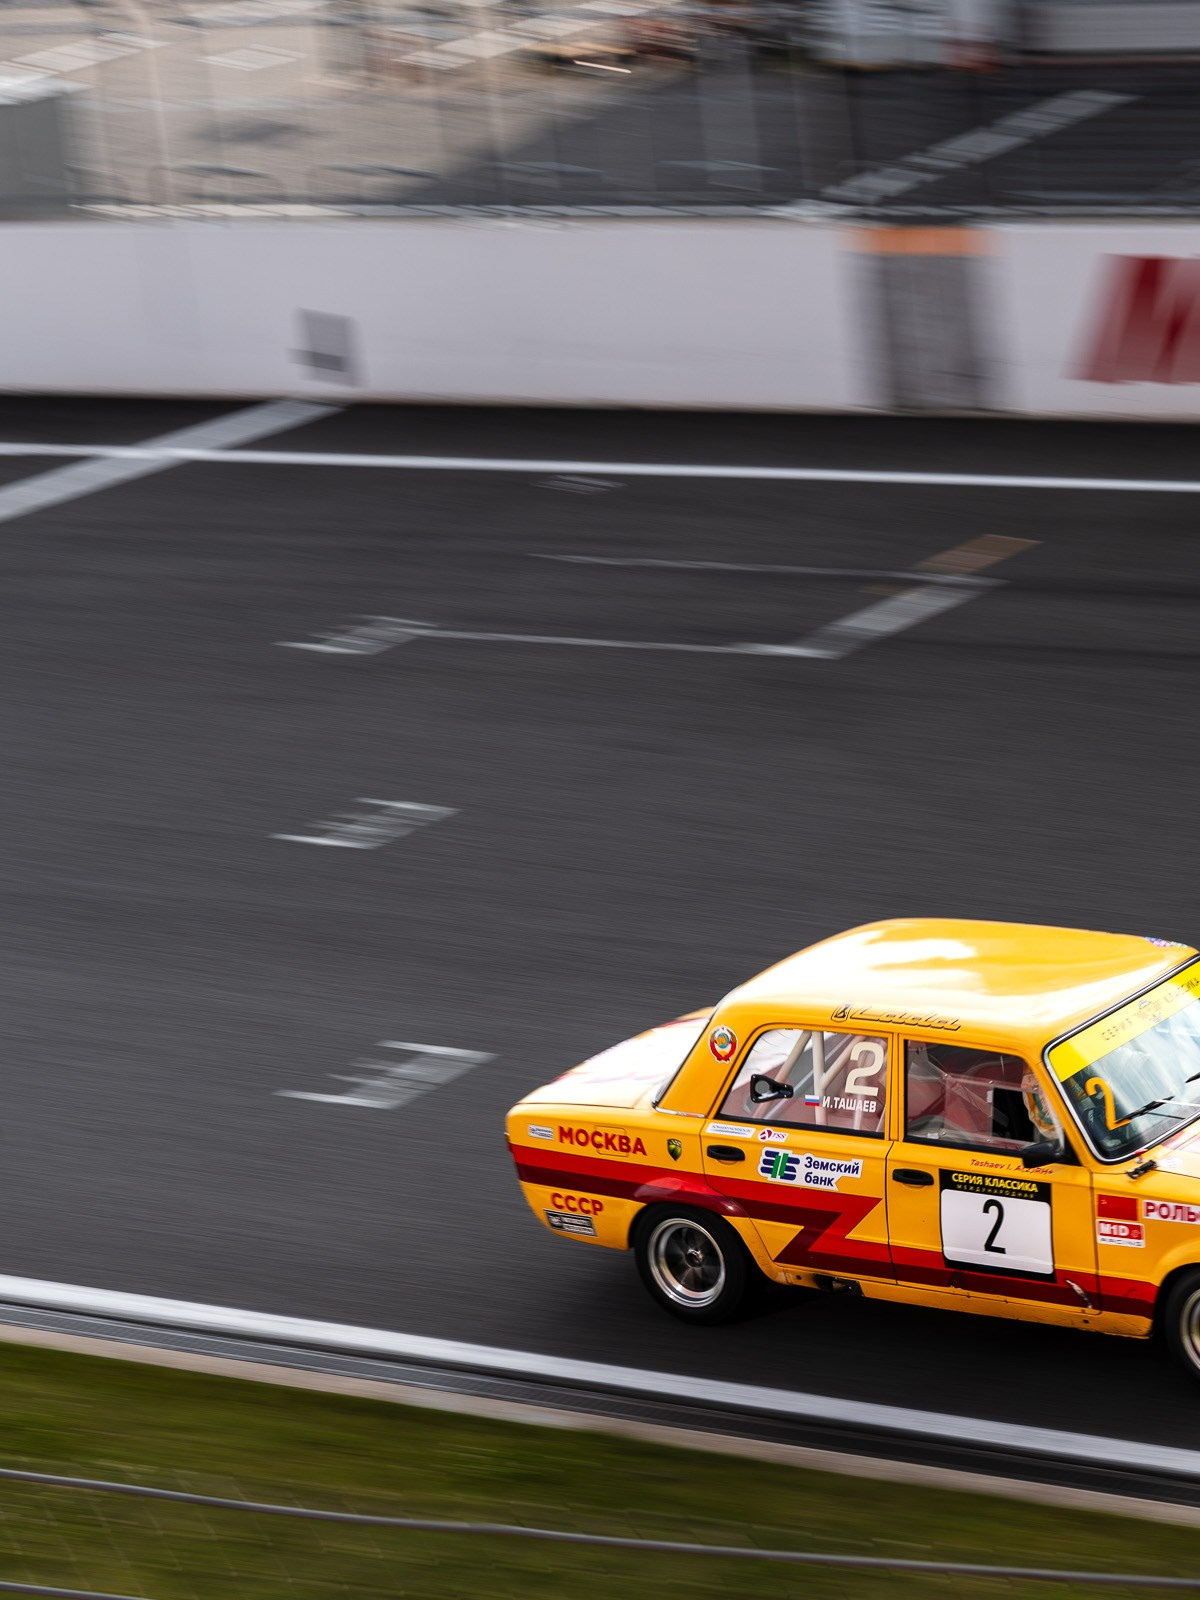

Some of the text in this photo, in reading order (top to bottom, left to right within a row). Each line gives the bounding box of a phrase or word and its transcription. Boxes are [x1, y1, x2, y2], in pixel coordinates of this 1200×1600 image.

[845, 1041, 884, 1096] 2
[822, 1095, 877, 1113] И.ТАШАЕВ
[1085, 1076, 1131, 1131] 2
[558, 1125, 648, 1156] МОСКВА
[804, 1156, 860, 1175] Земский
[970, 1158, 1005, 1169] Tashaev
[804, 1172, 835, 1187] банк
[951, 1173, 1039, 1193] СЕРИЯ КЛАССИКА
[551, 1192, 604, 1216] СССР
[982, 1198, 1006, 1255] 2
